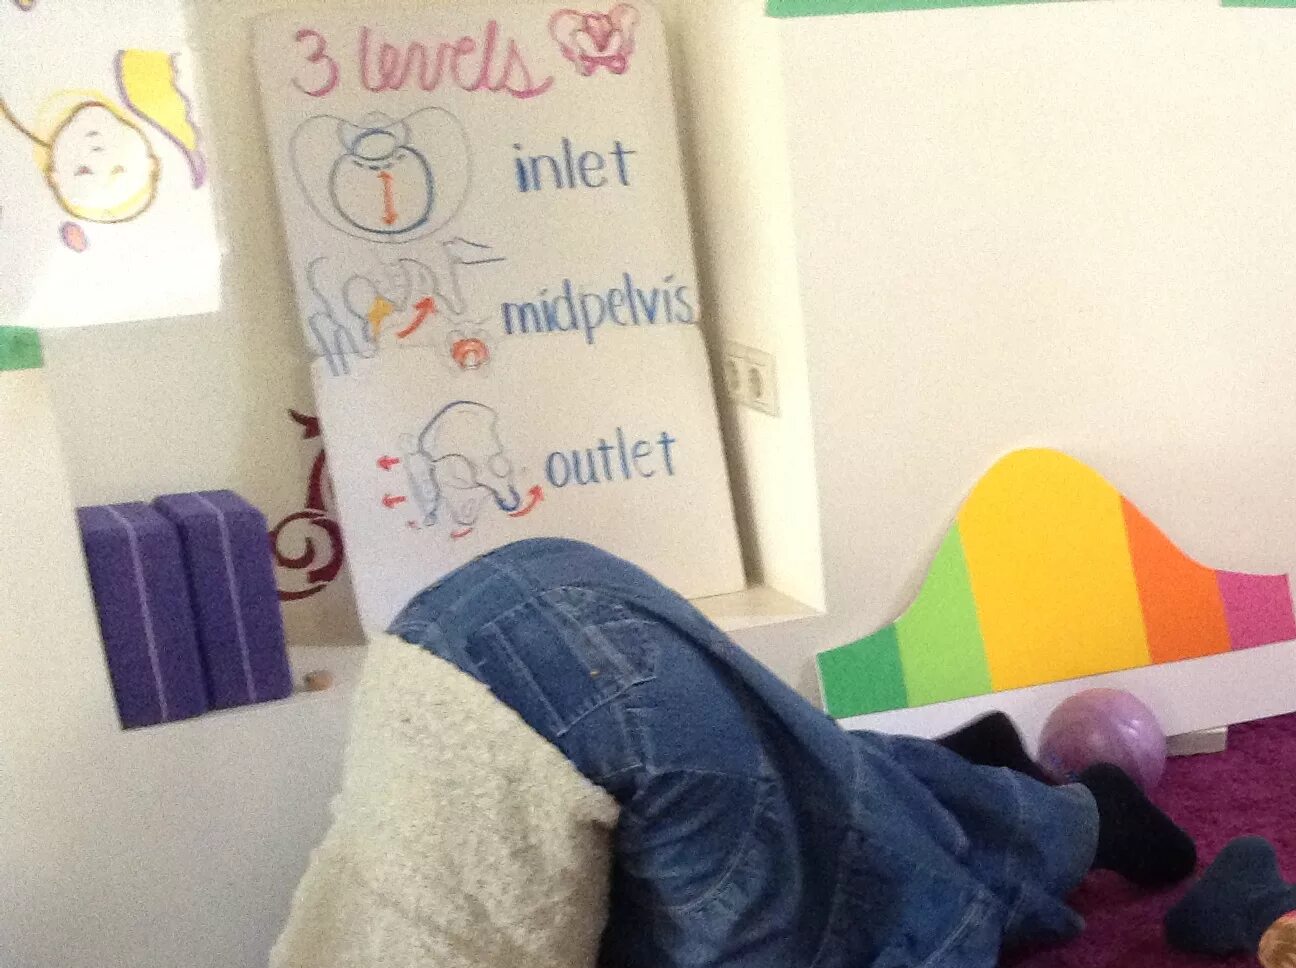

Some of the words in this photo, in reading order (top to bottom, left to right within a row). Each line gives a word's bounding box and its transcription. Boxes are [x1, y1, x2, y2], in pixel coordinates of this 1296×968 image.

[292, 29, 339, 97] 3
[358, 19, 555, 99] levels
[513, 138, 636, 193] inlet
[501, 273, 697, 345] midpelvis
[545, 428, 678, 488] outlet
